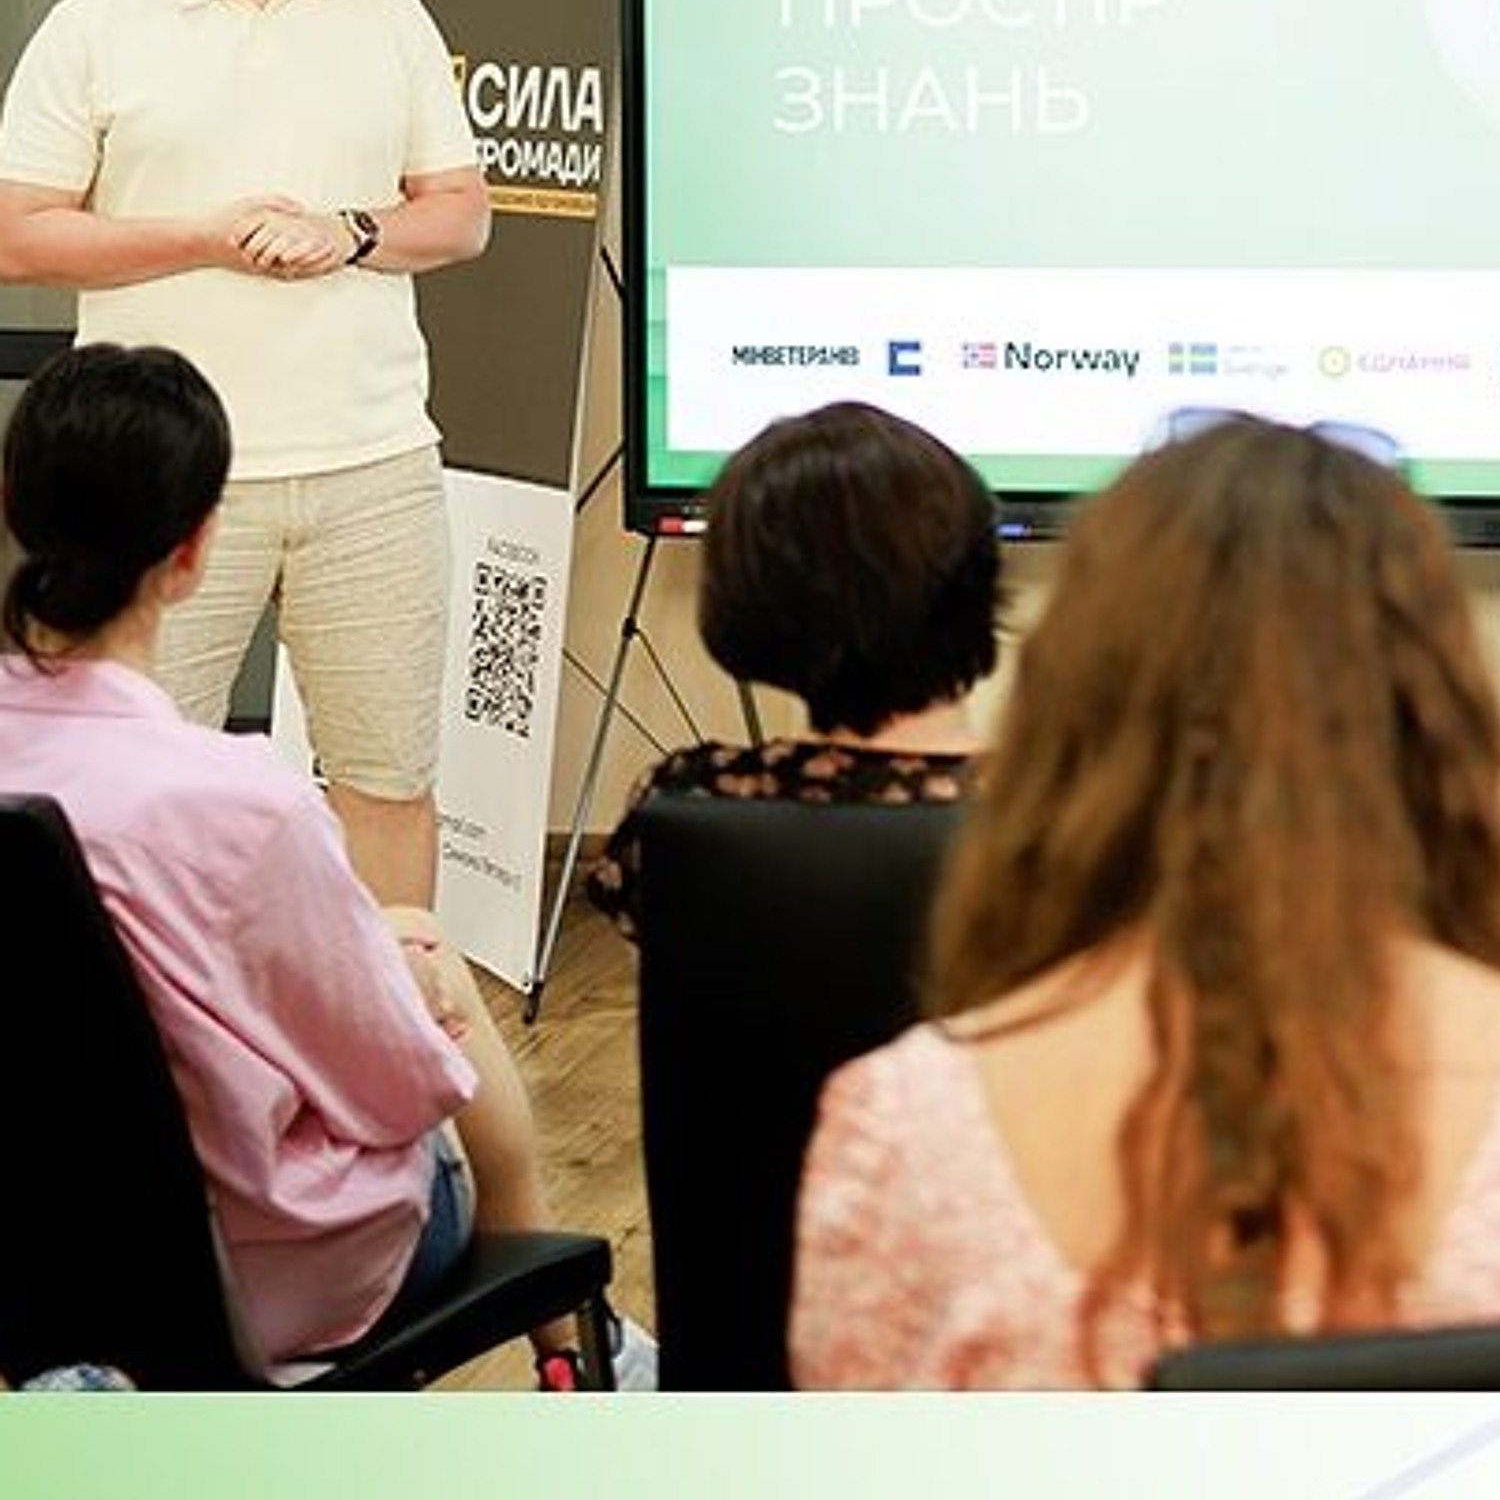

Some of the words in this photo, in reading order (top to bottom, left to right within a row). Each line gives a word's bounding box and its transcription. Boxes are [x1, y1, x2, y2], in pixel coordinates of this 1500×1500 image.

[469, 62, 603, 133] СИЛА
[772, 65, 1090, 133] ЗНАНЬ
[1004, 342, 1140, 379] Norway
